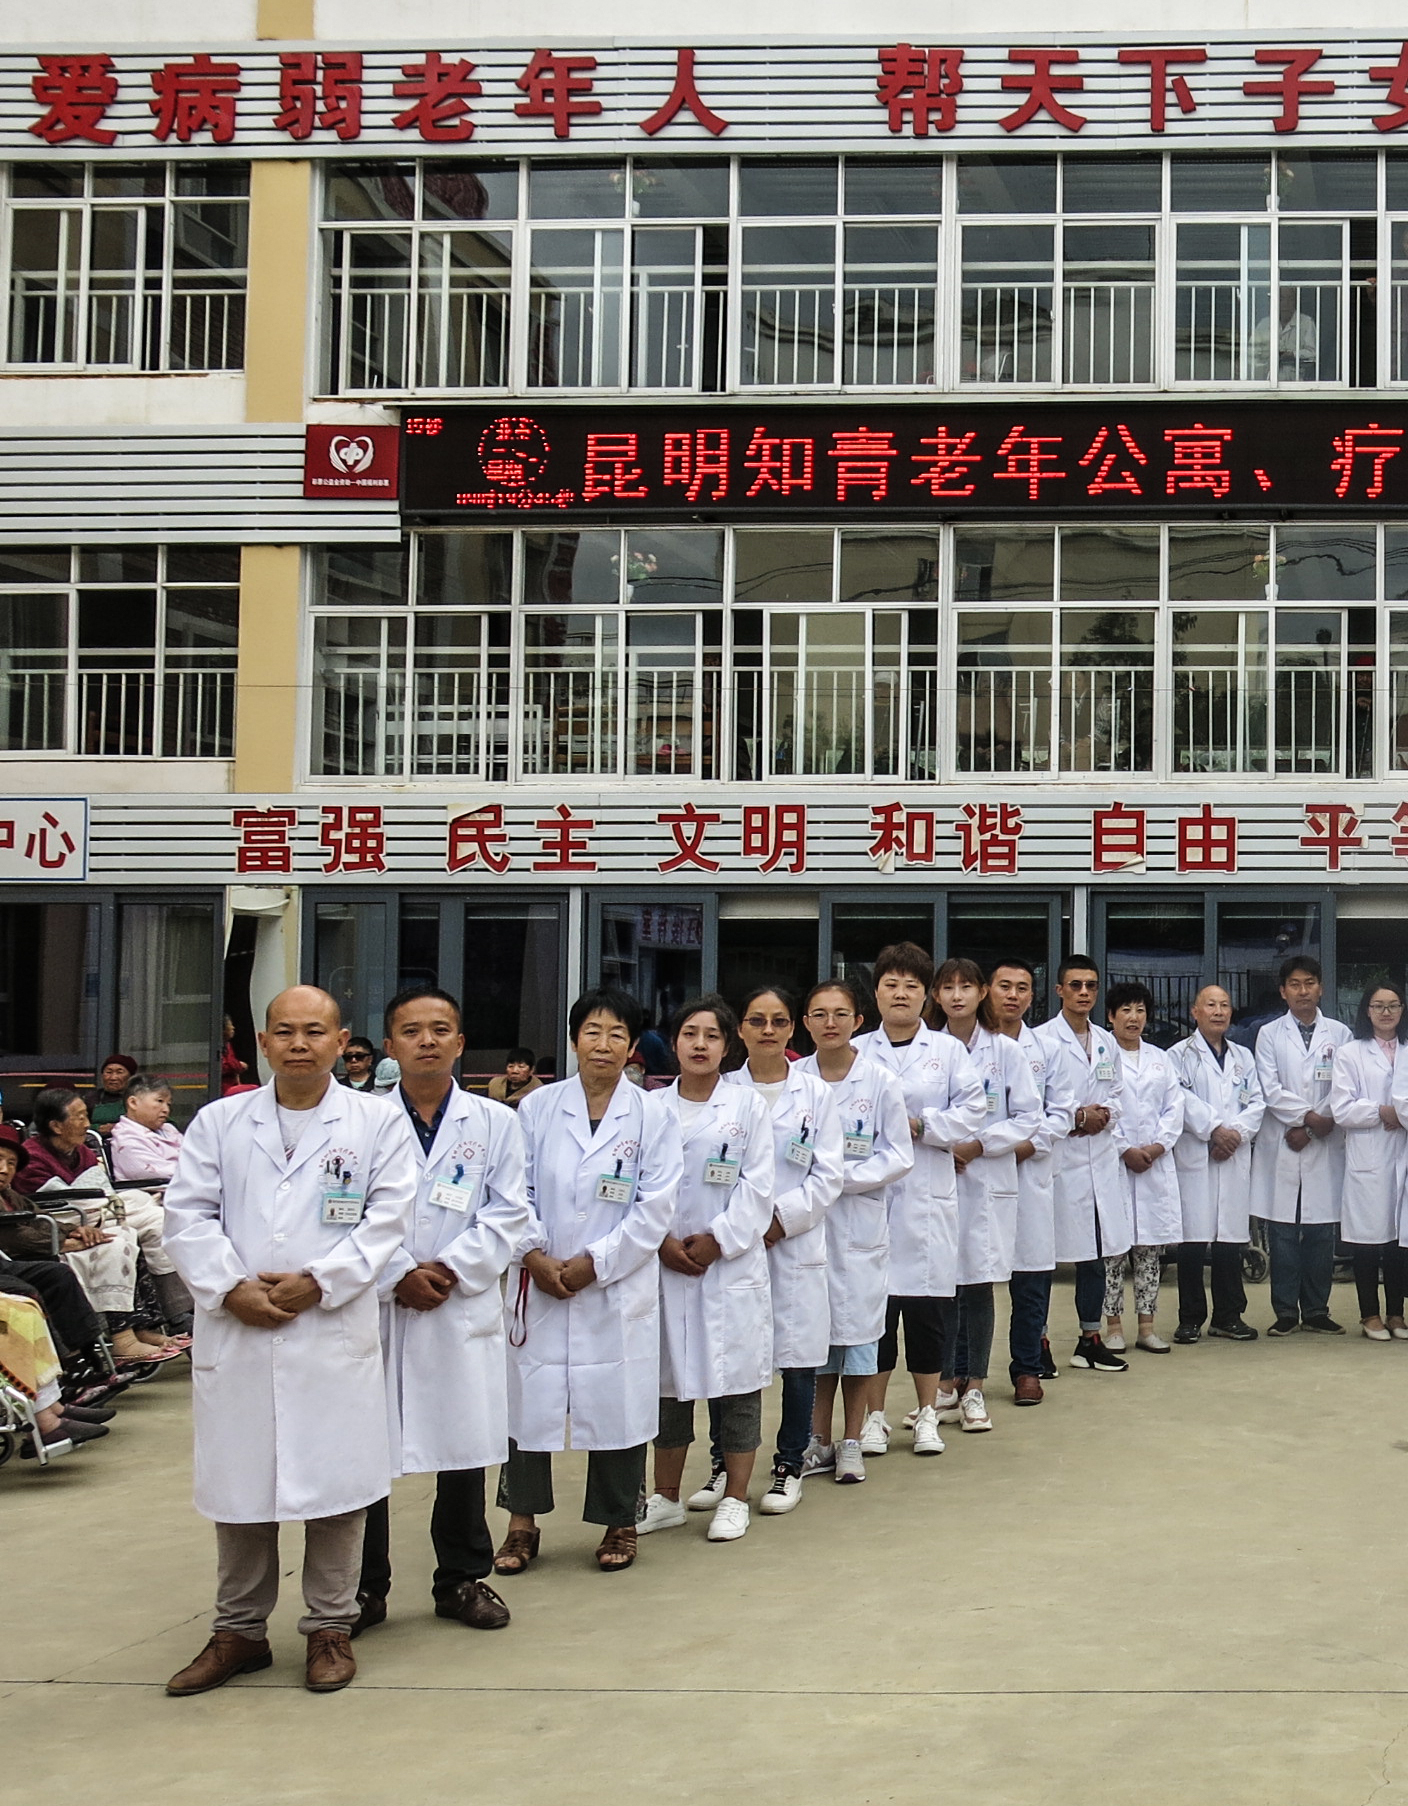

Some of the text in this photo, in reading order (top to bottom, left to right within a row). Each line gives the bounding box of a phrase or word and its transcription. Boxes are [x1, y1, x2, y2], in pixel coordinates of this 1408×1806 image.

[29, 48, 729, 145] 爱病弱老年人
[232, 807, 386, 873] 富强
[449, 803, 598, 874] 民主
[658, 803, 807, 873] 文明
[870, 803, 1024, 874] 和谐
[1094, 803, 1239, 872] 自由
